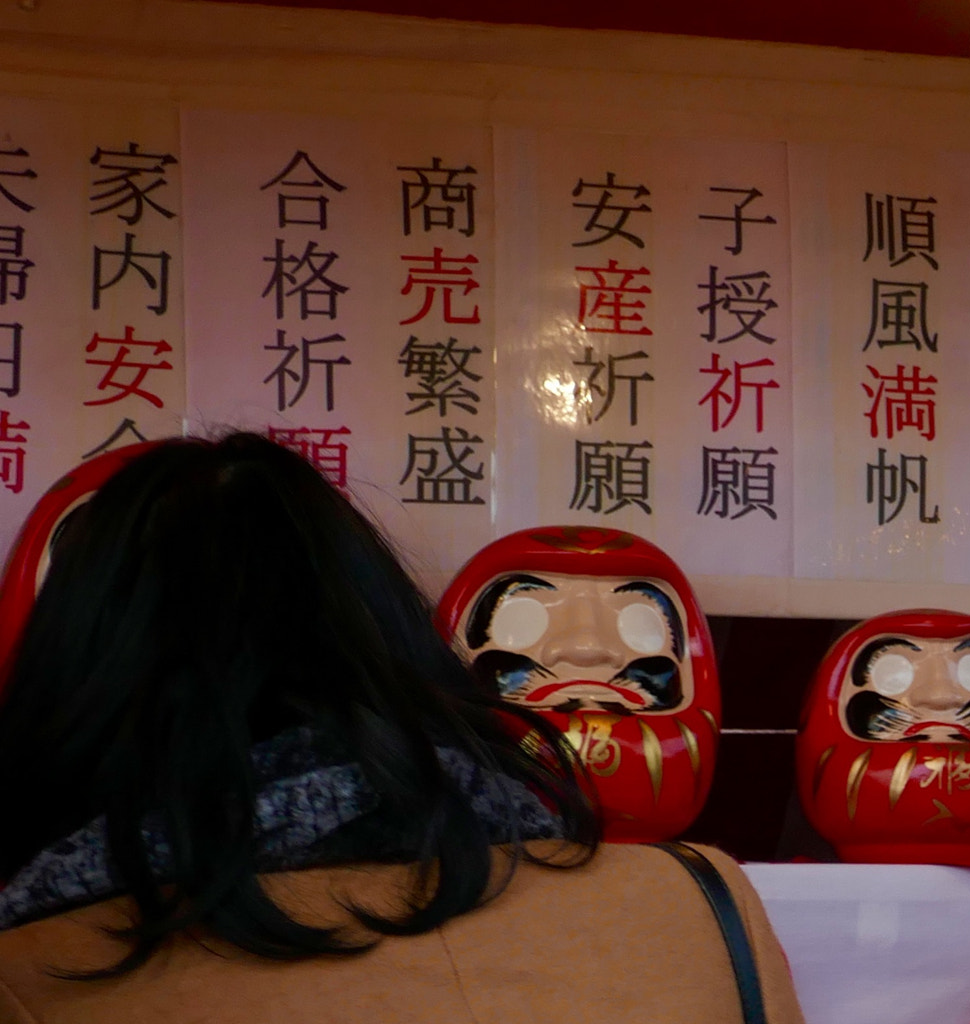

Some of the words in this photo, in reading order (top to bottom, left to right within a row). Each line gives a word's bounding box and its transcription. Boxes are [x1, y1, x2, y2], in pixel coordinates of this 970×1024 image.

[396, 157, 486, 506] 商売繁盛
[568, 172, 655, 516] 安産祈願
[696, 186, 780, 521] 子授祈願
[861, 192, 941, 526] 順風満帆
